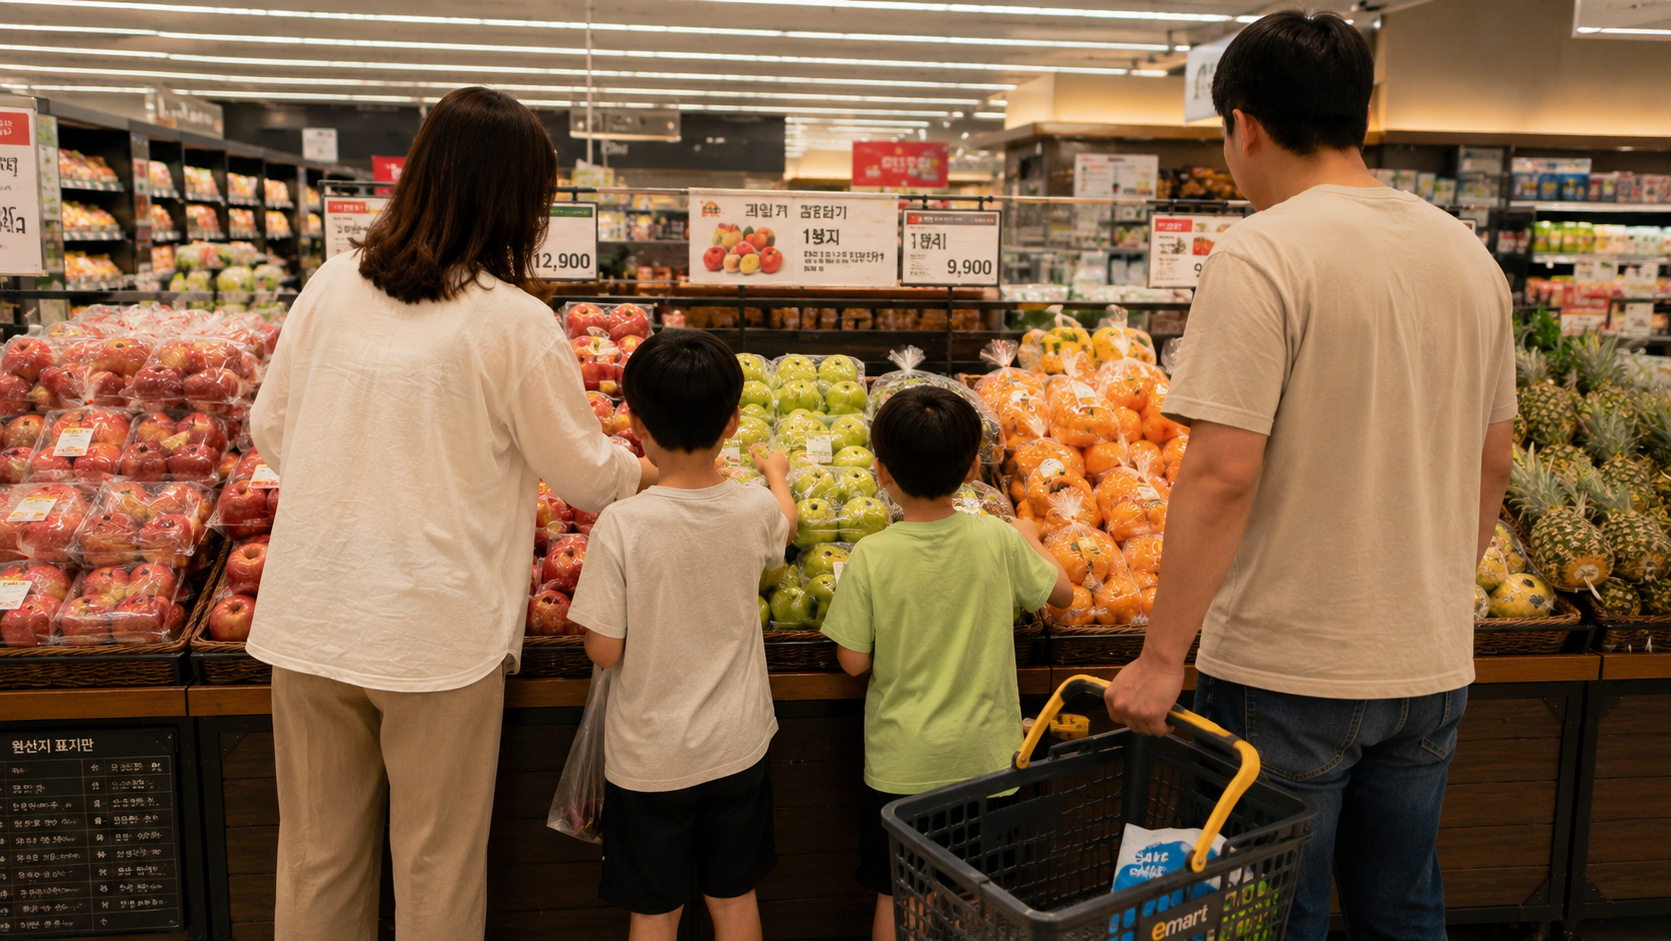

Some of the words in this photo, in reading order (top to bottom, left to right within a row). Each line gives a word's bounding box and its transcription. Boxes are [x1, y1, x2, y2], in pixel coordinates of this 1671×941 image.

[533, 252, 591, 272] 12,900
[947, 259, 992, 278] 9,900
[11, 738, 51, 755] 원산지
[1151, 903, 1209, 941] emart
